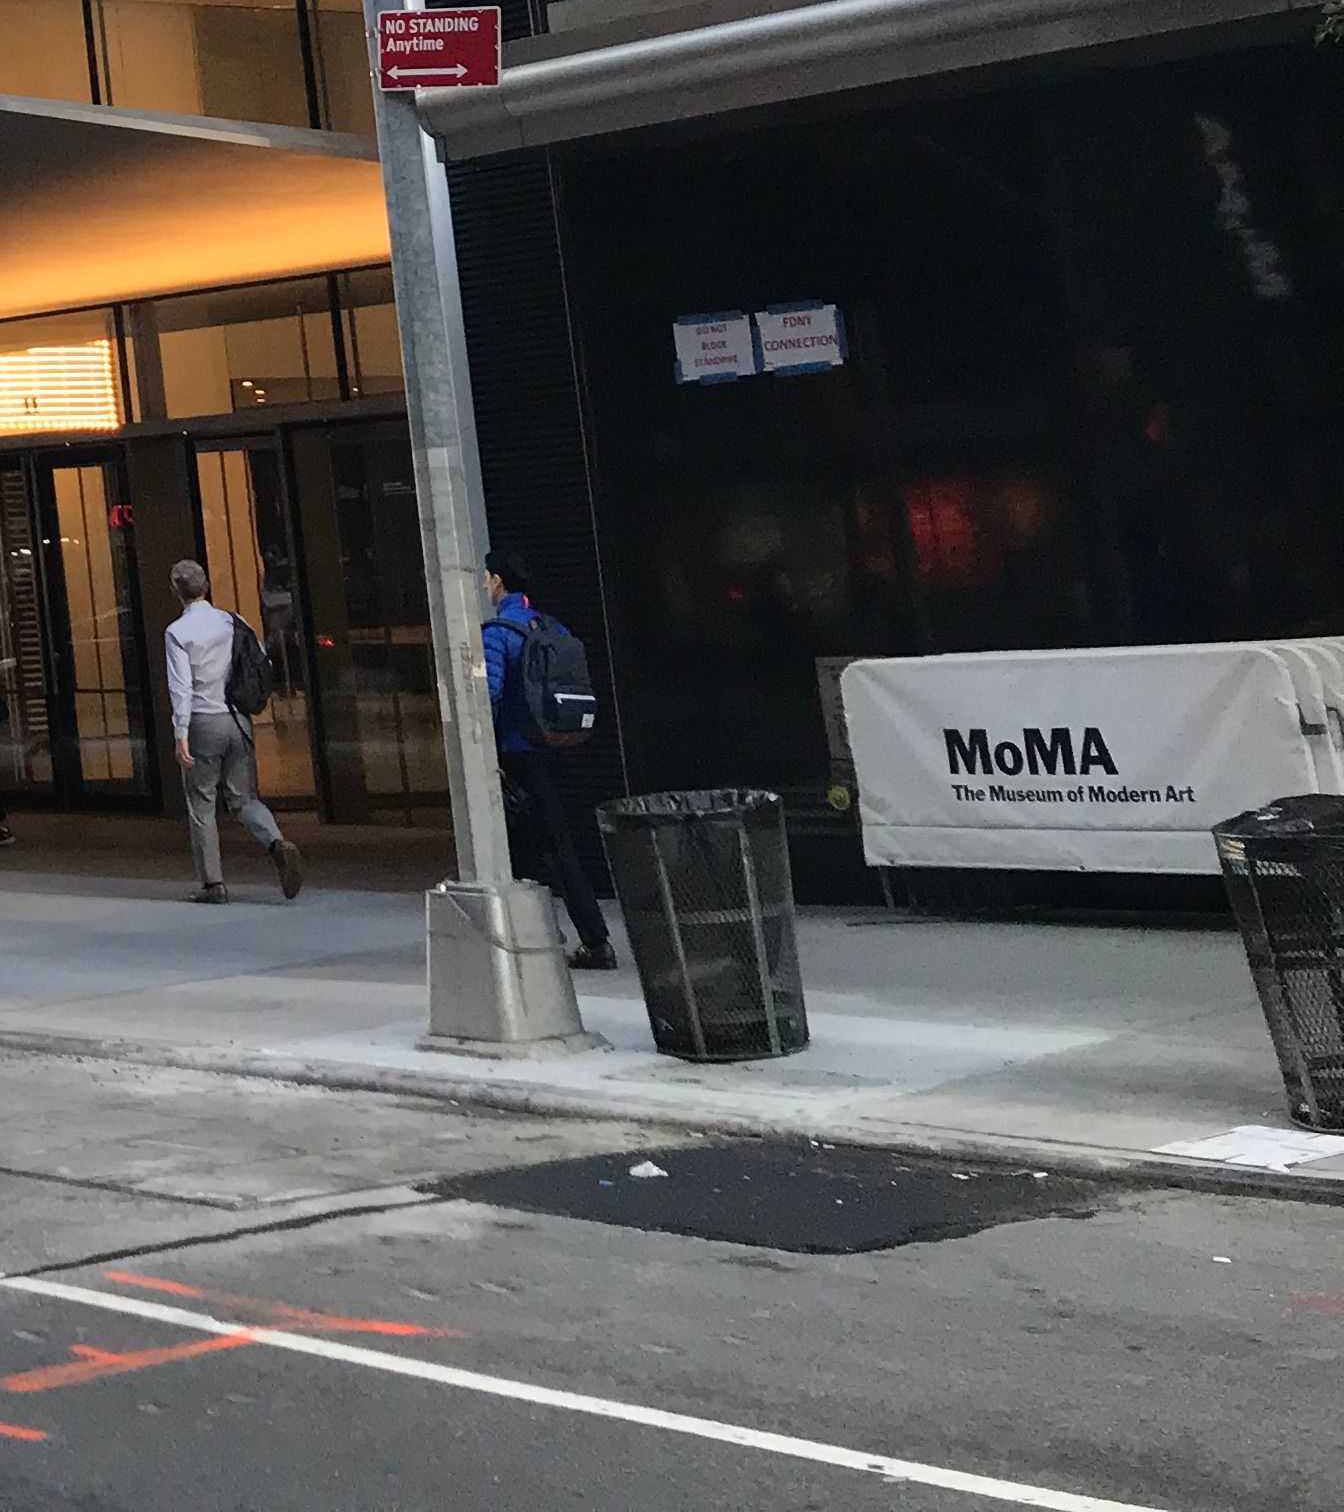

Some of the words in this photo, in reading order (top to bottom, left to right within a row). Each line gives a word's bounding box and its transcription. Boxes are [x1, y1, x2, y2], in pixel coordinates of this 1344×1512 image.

[385, 19, 406, 35] NO
[408, 16, 479, 33] STANDING
[386, 36, 445, 55] Anytime
[782, 315, 813, 329] FDNY
[764, 335, 838, 351] CONNECTION
[943, 727, 1120, 776] MoMA
[952, 784, 986, 802] The
[988, 784, 1064, 803] Museum
[1066, 784, 1085, 803] of
[1088, 785, 1162, 803] Modern
[1164, 785, 1197, 803] Art
